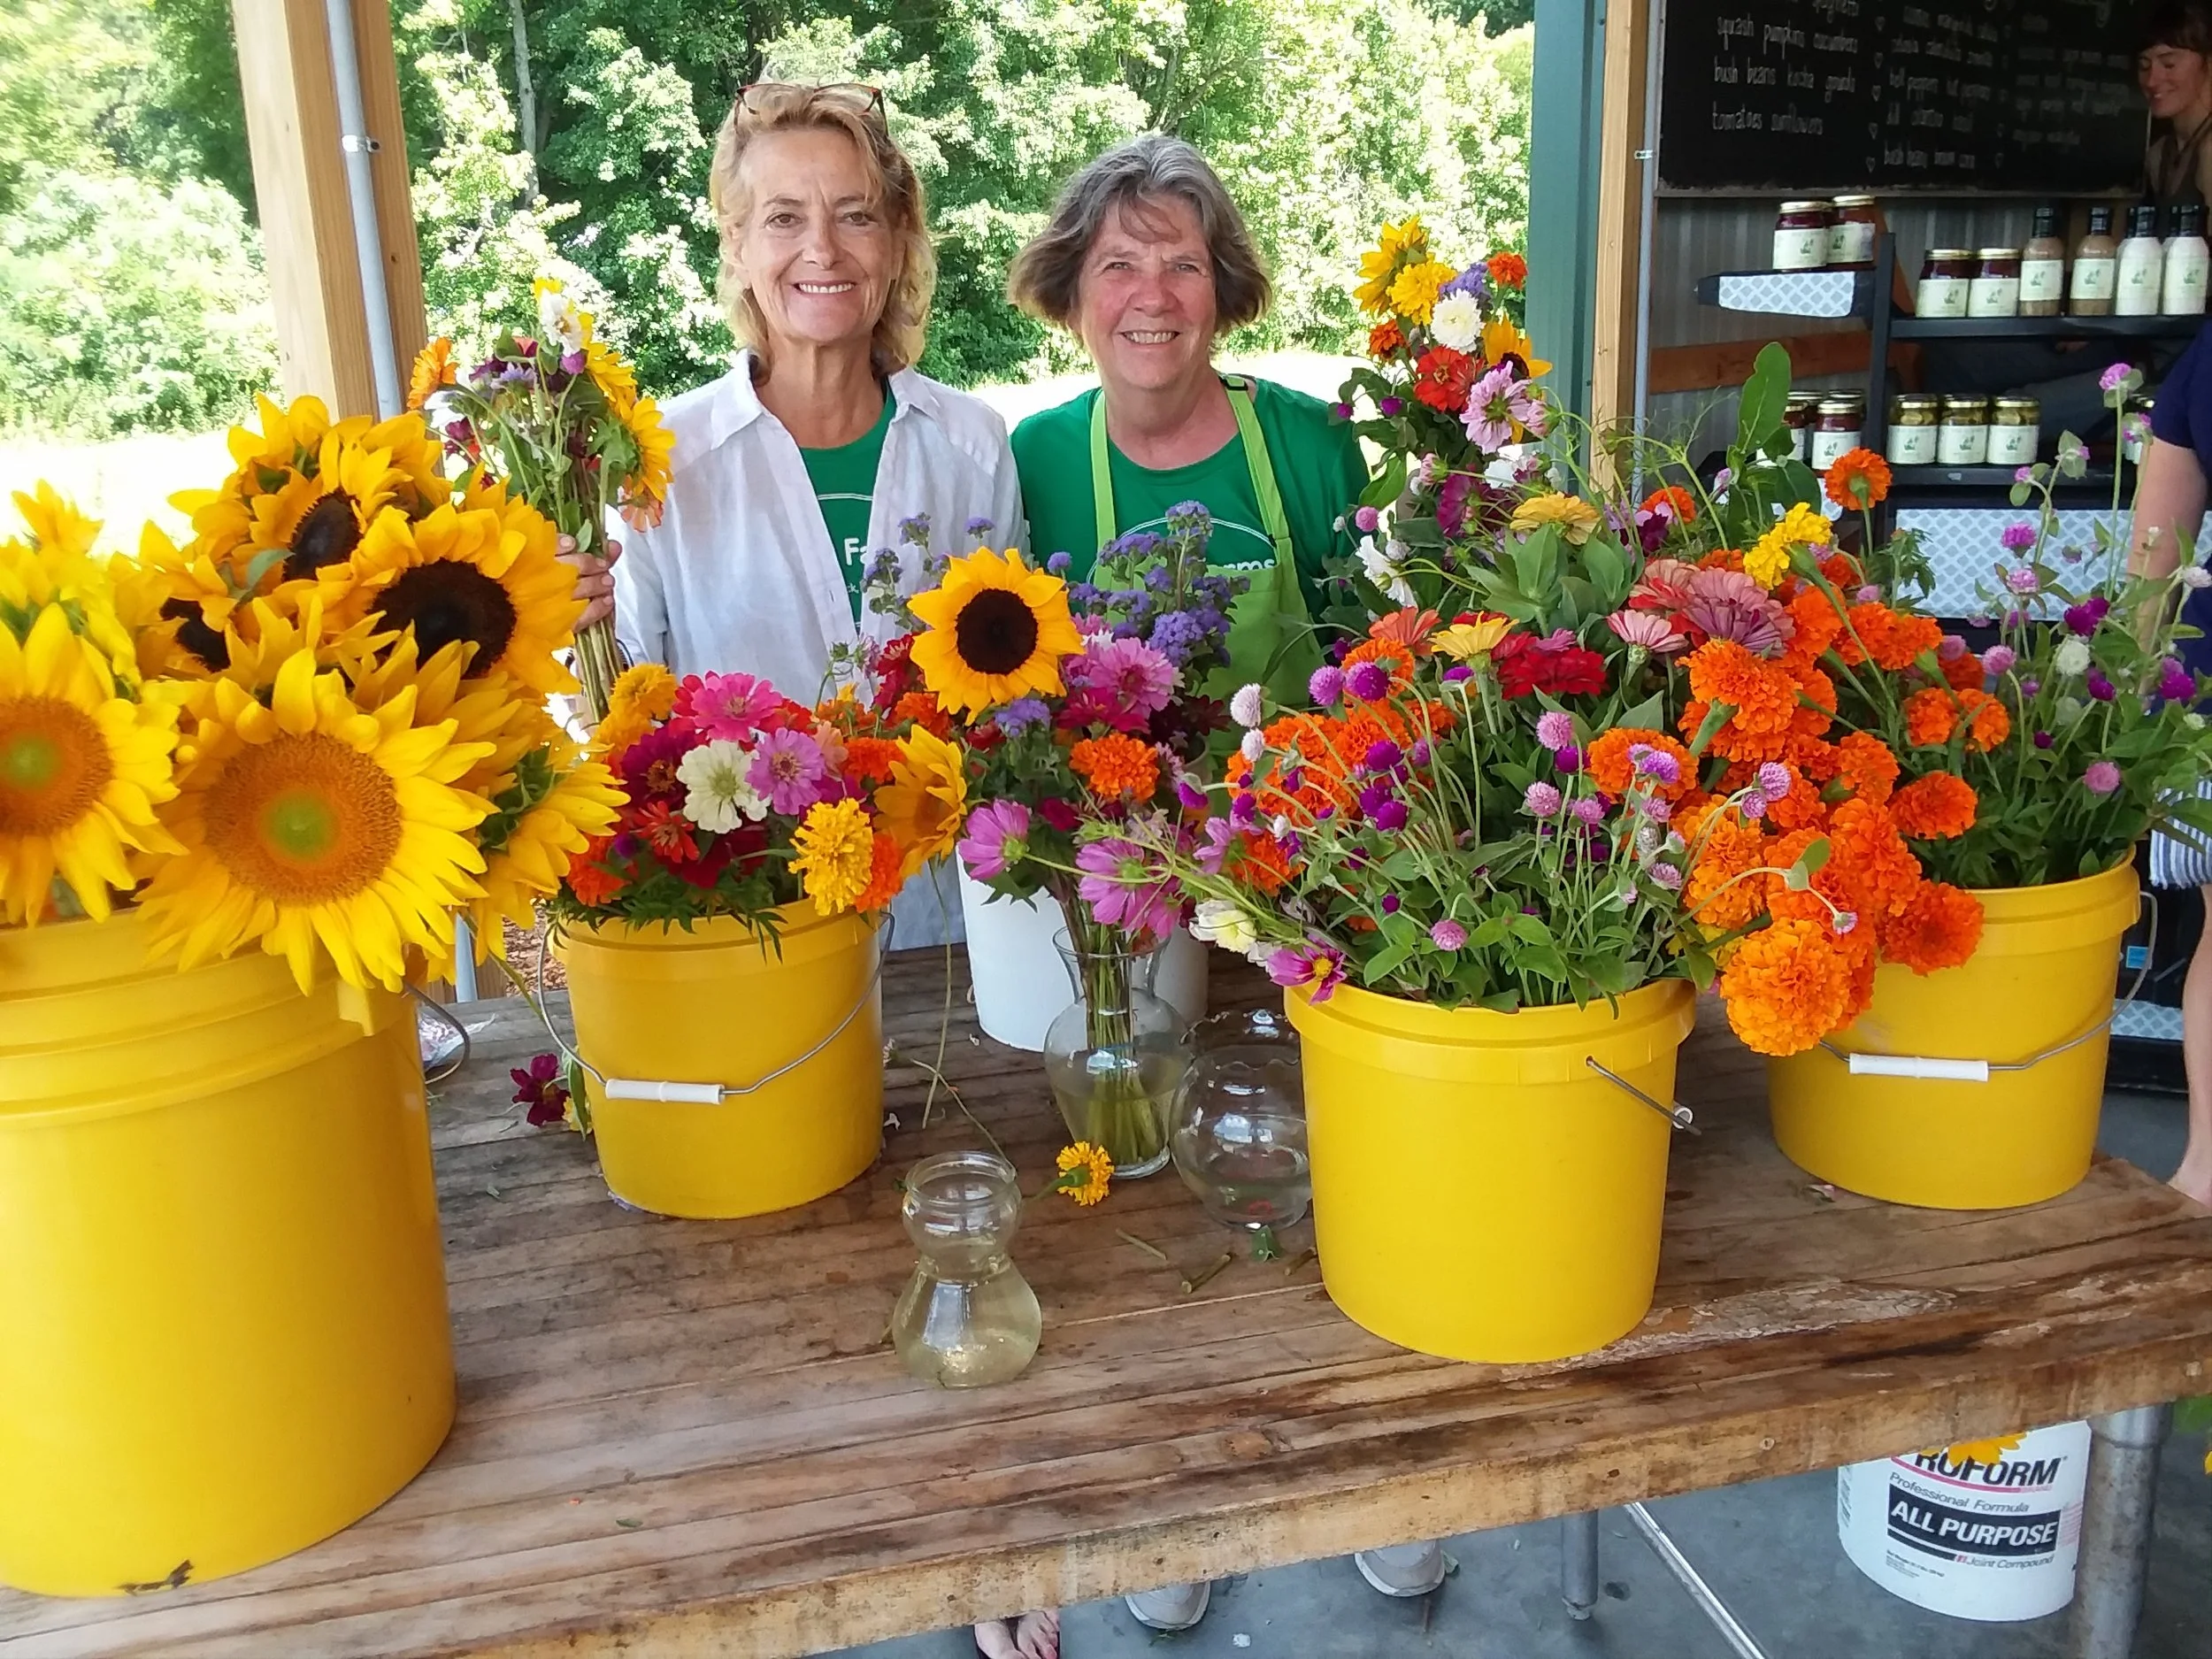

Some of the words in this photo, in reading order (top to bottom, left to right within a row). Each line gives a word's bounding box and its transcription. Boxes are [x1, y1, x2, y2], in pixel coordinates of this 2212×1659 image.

[1714, 55, 1739, 84] bush
[1915, 1449, 2062, 1486] ROFORM
[1889, 1471, 1970, 1508] Professional
[1973, 1500, 2029, 1513] Formula
[1891, 1501, 1935, 1532] ALL
[1939, 1518, 2058, 1547] PURPOSE
[1966, 1555, 1996, 1568] Joint
[1997, 1555, 2055, 1571] Compound
